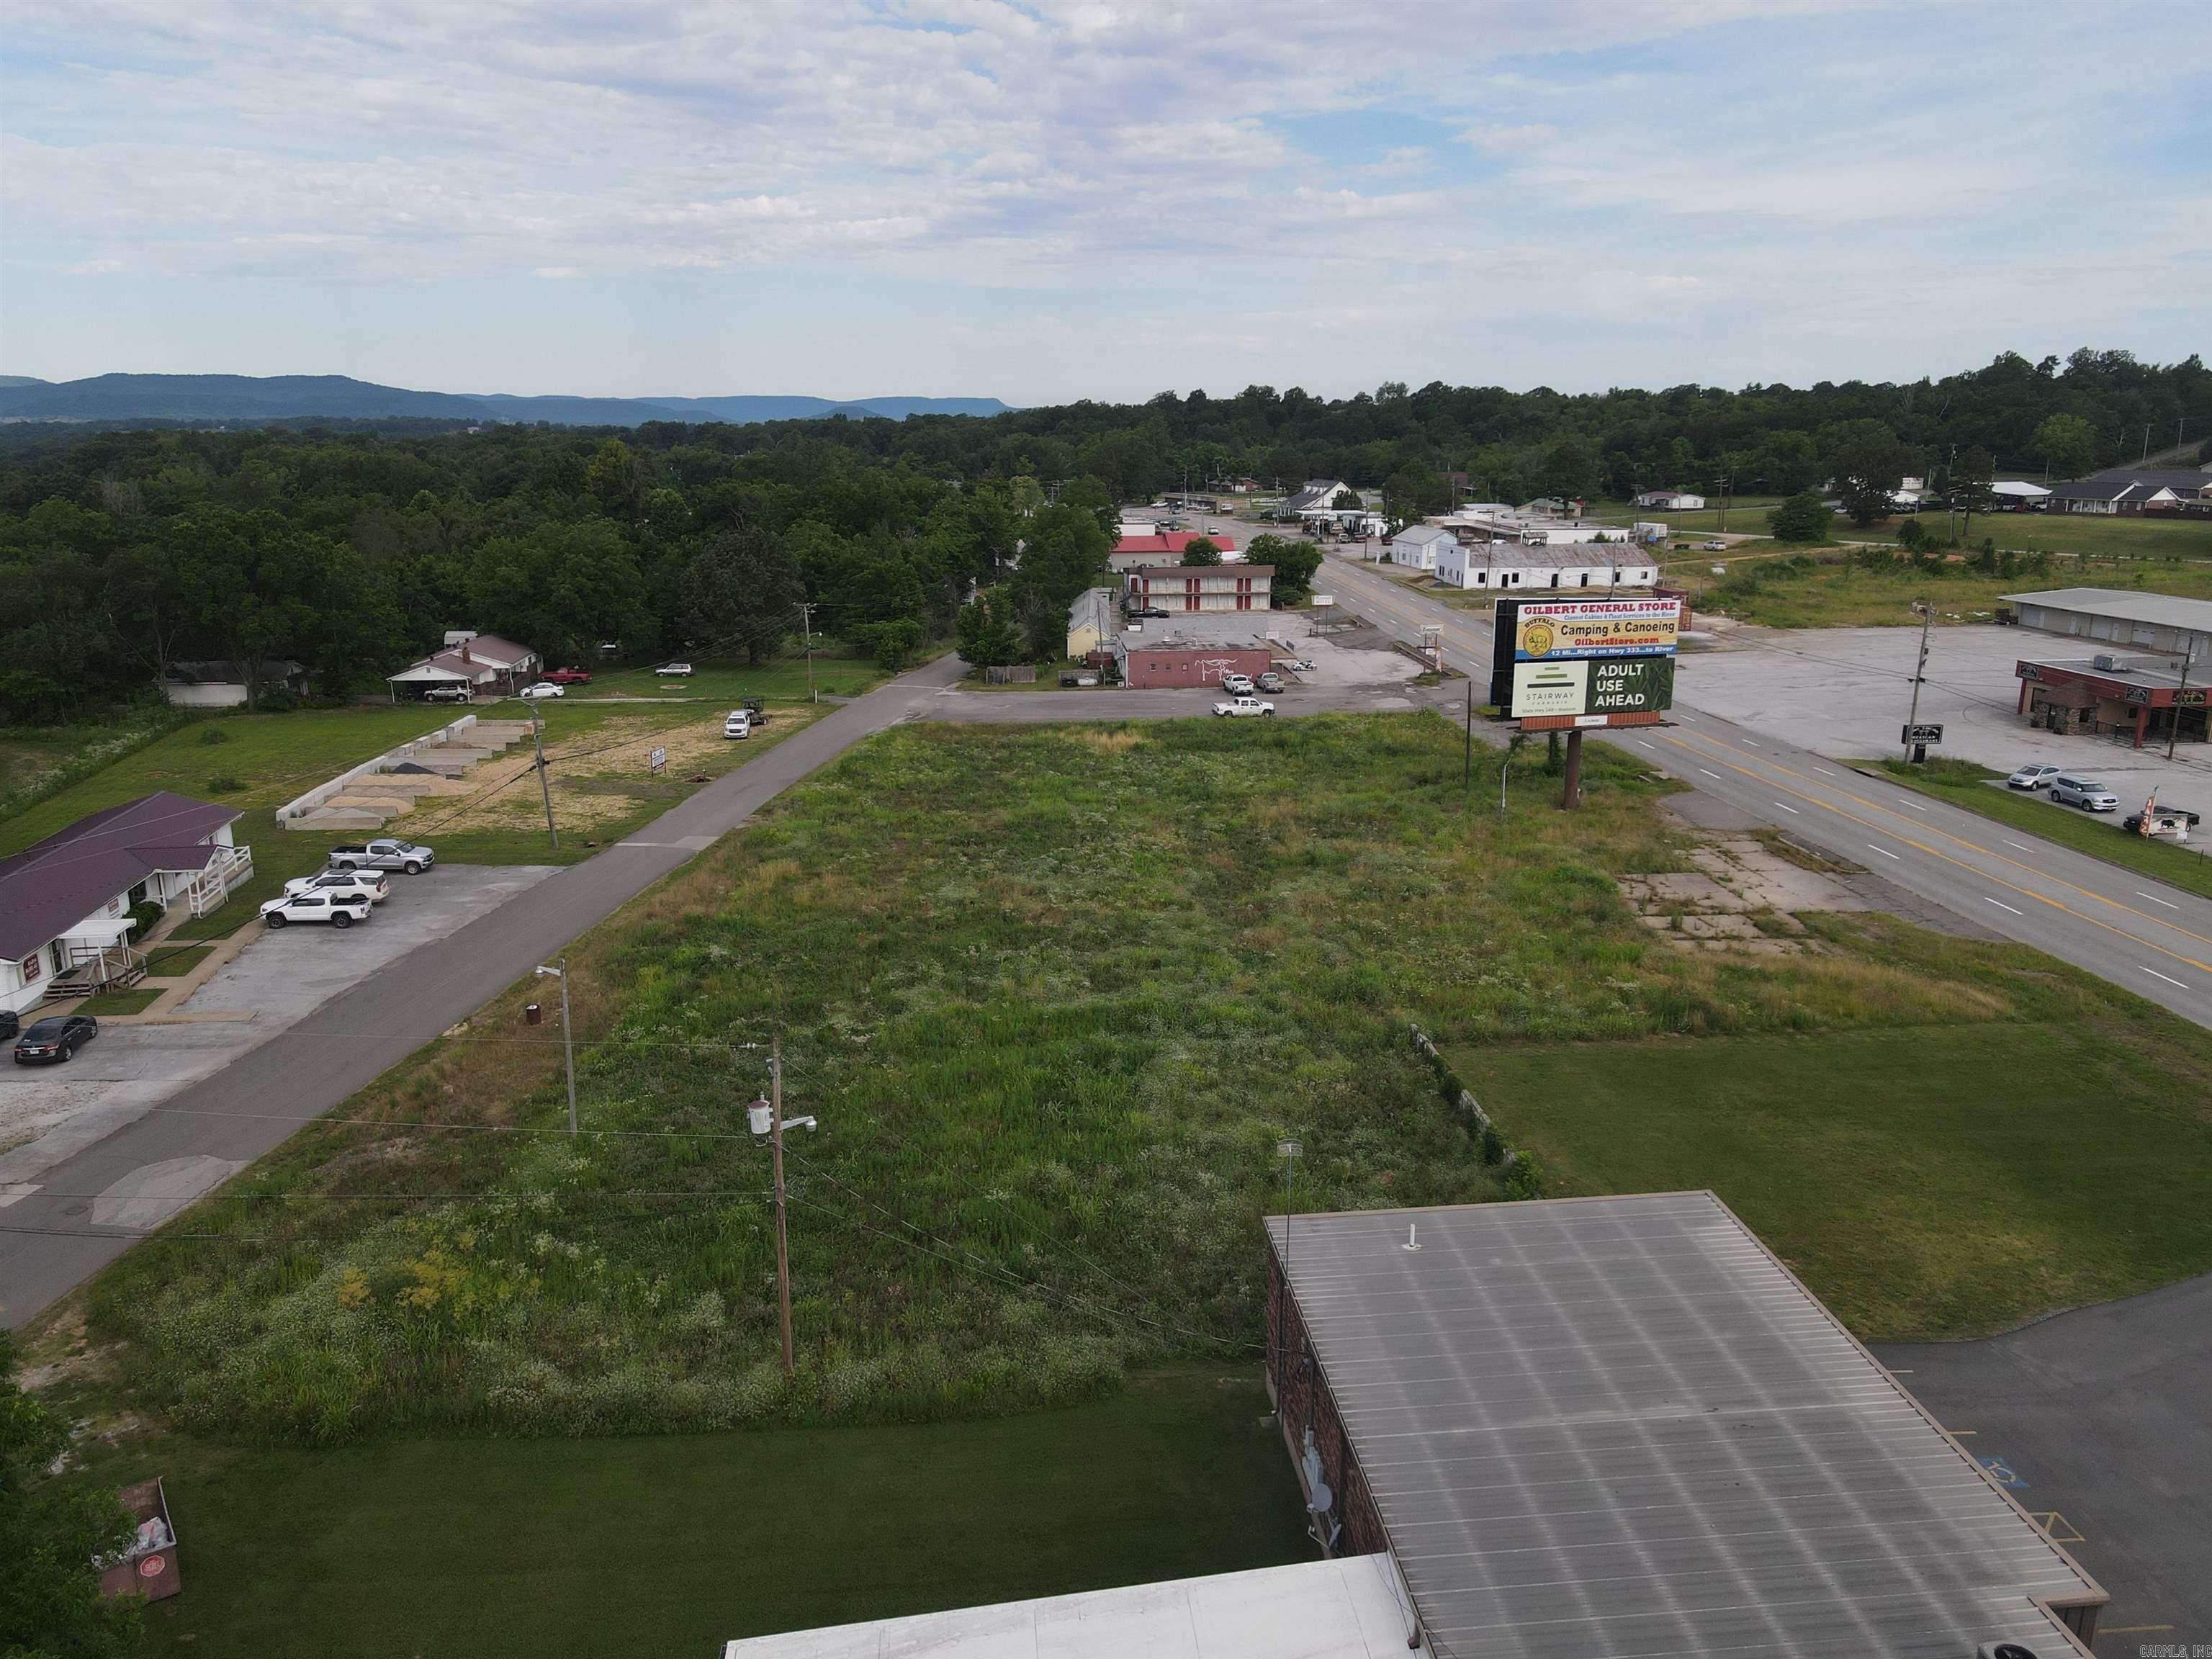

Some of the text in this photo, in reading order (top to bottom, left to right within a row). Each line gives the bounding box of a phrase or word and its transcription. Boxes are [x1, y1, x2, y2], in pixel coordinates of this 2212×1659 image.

[1524, 602, 1676, 614] GILBERT GENERAL STORE
[1524, 618, 1555, 628] BUFFALO
[1561, 624, 1609, 637] Camping
[1613, 622, 1621, 633] &
[1624, 621, 1675, 634] Canoeing
[1597, 664, 1644, 677] ADULT
[1596, 680, 1624, 692] USE
[1526, 692, 1575, 701] STAIRWAY
[1595, 693, 1645, 706] AHEAD
